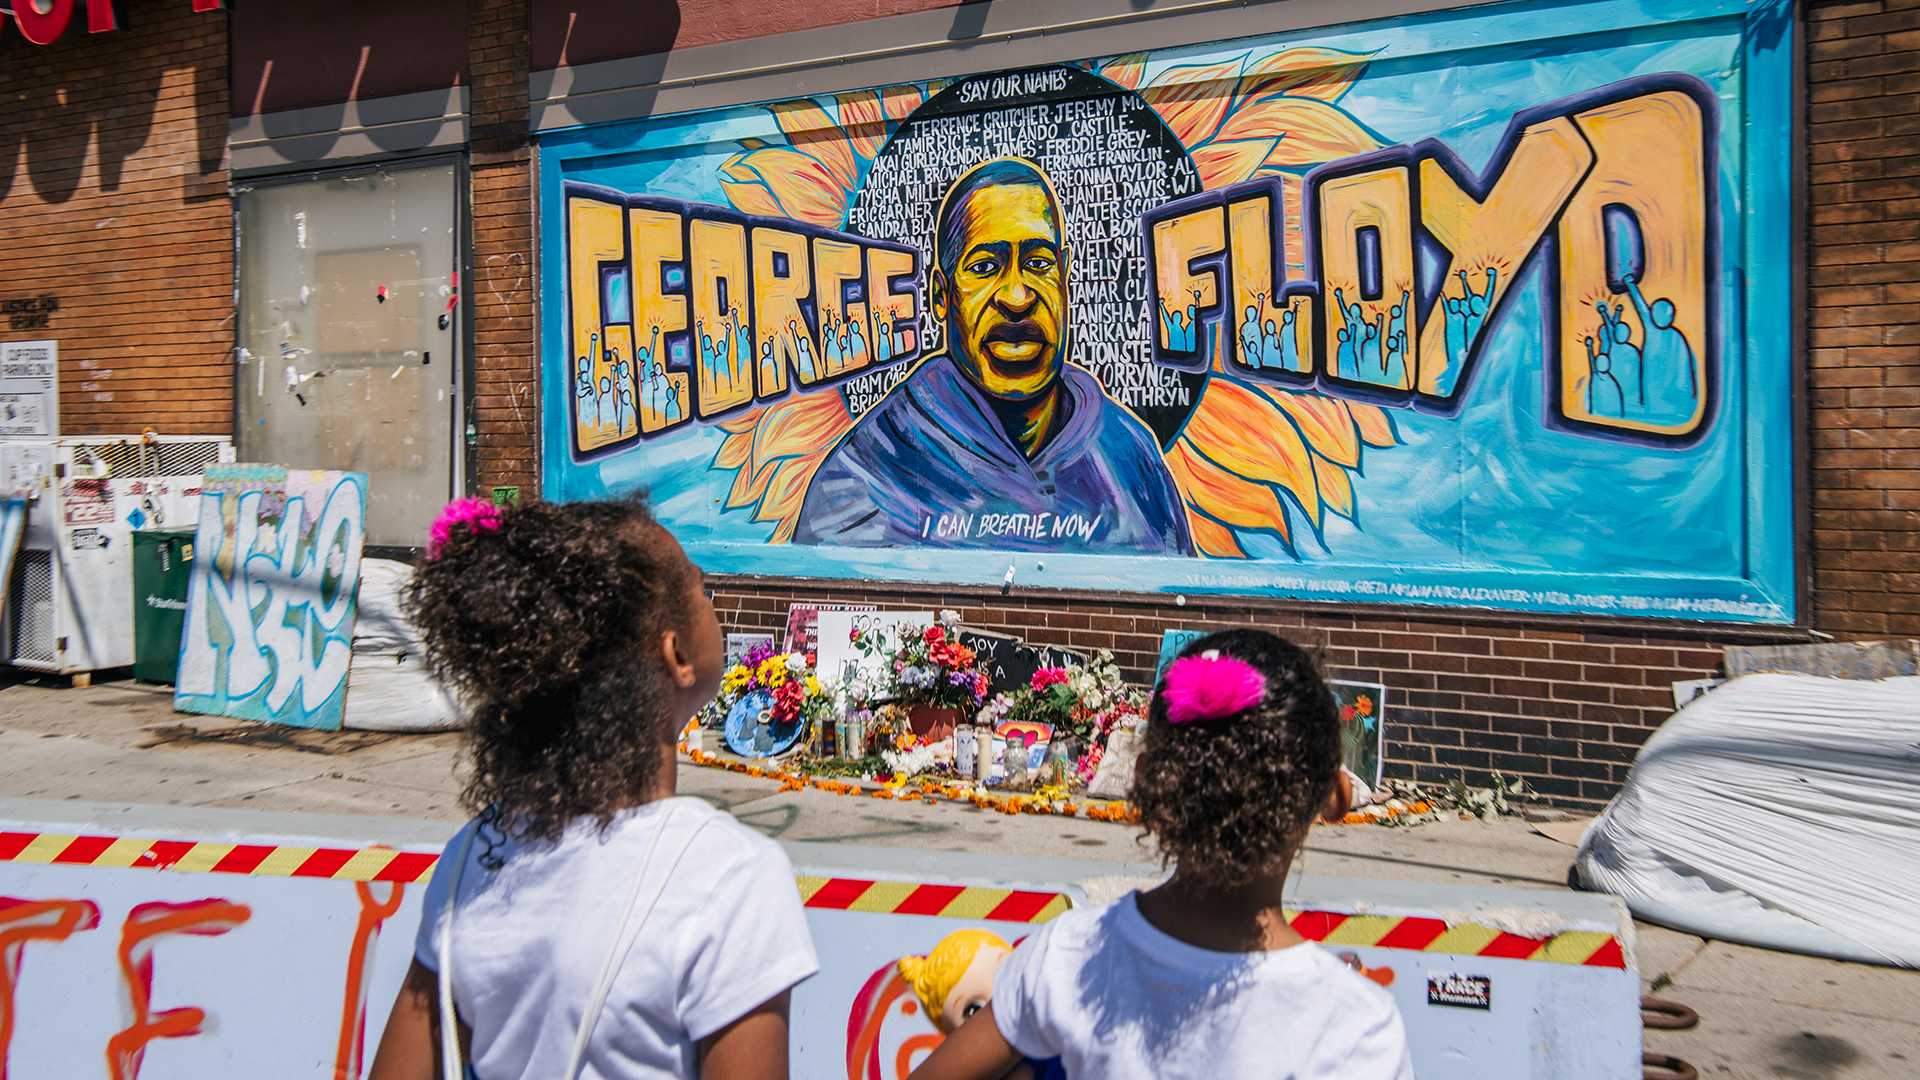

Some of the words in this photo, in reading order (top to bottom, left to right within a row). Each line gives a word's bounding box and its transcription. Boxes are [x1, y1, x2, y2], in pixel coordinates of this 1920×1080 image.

[959, 79, 992, 103] SAY
[992, 75, 1023, 98] OUR
[1024, 69, 1067, 94] NAMES
[910, 114, 981, 139] TERRENCE
[983, 104, 1050, 130] CRUTCHER
[1054, 97, 1116, 123] JEREMY
[895, 135, 937, 156] TAMIR
[937, 133, 971, 154] RICE
[982, 123, 1059, 147] PHILANDO
[1071, 114, 1129, 138] CASTILE
[872, 154, 899, 174] AKAI
[900, 151, 941, 171] GURLEY
[941, 145, 991, 168] KENDRA
[991, 139, 1037, 160] JAMES
[1046, 133, 1105, 157] FREDDIE
[1107, 129, 1147, 152] GREY
[1038, 150, 1097, 172] TERRANCE
[1100, 146, 1163, 168] FRANKLIN
[866, 168, 922, 190] MICHAEL
[1050, 165, 1115, 188] BREONNA
[1111, 160, 1169, 183] TAYLOR
[1173, 156, 1195, 178] AL
[858, 187, 902, 207] TYISHA
[905, 182, 947, 203] MILLE
[1058, 183, 1122, 206] SHANTEL
[1123, 177, 1167, 200] DAVIS
[849, 206, 877, 225] ERIC
[877, 202, 933, 222] GARNER
[1062, 201, 1121, 224] WALTER
[857, 219, 910, 239] SANDRA
[911, 214, 937, 236] BLA
[1065, 219, 1107, 242] REKIA
[562, 180, 925, 464] GEORGE
[1142, 72, 1722, 452] FLOYD
[1070, 258, 1123, 282] SHELLY
[1068, 280, 1123, 305] JAMAR
[1069, 302, 1135, 326] TANISHA
[1069, 322, 1126, 344] TARIKA
[1070, 341, 1120, 366] ALTON
[1111, 385, 1190, 408] KATHRYN
[922, 515, 931, 538] I
[936, 512, 974, 538] CAN
[975, 511, 1052, 540] BREATHE
[1051, 514, 1102, 543] NOW
[967, 637, 998, 658] JOY
[995, 664, 1006, 679] A
